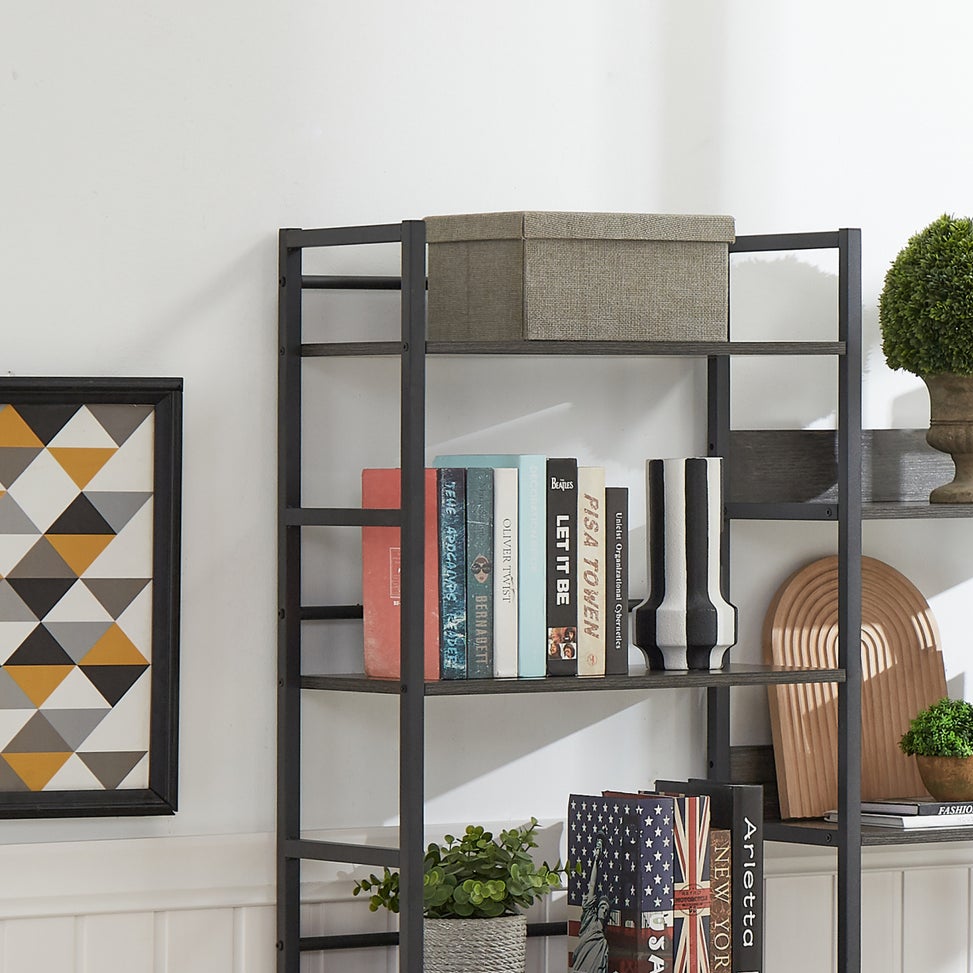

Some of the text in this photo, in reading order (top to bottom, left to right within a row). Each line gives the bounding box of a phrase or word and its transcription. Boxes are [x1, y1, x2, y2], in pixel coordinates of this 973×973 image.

[502, 518, 514, 603] OLIVER TWIST
[556, 515, 570, 605] LET IT BE
[583, 493, 599, 547] PISA
[614, 512, 623, 649] Unicist Organizational Cybernetics
[714, 843, 730, 904] NEW
[743, 816, 757, 947] Arletta
